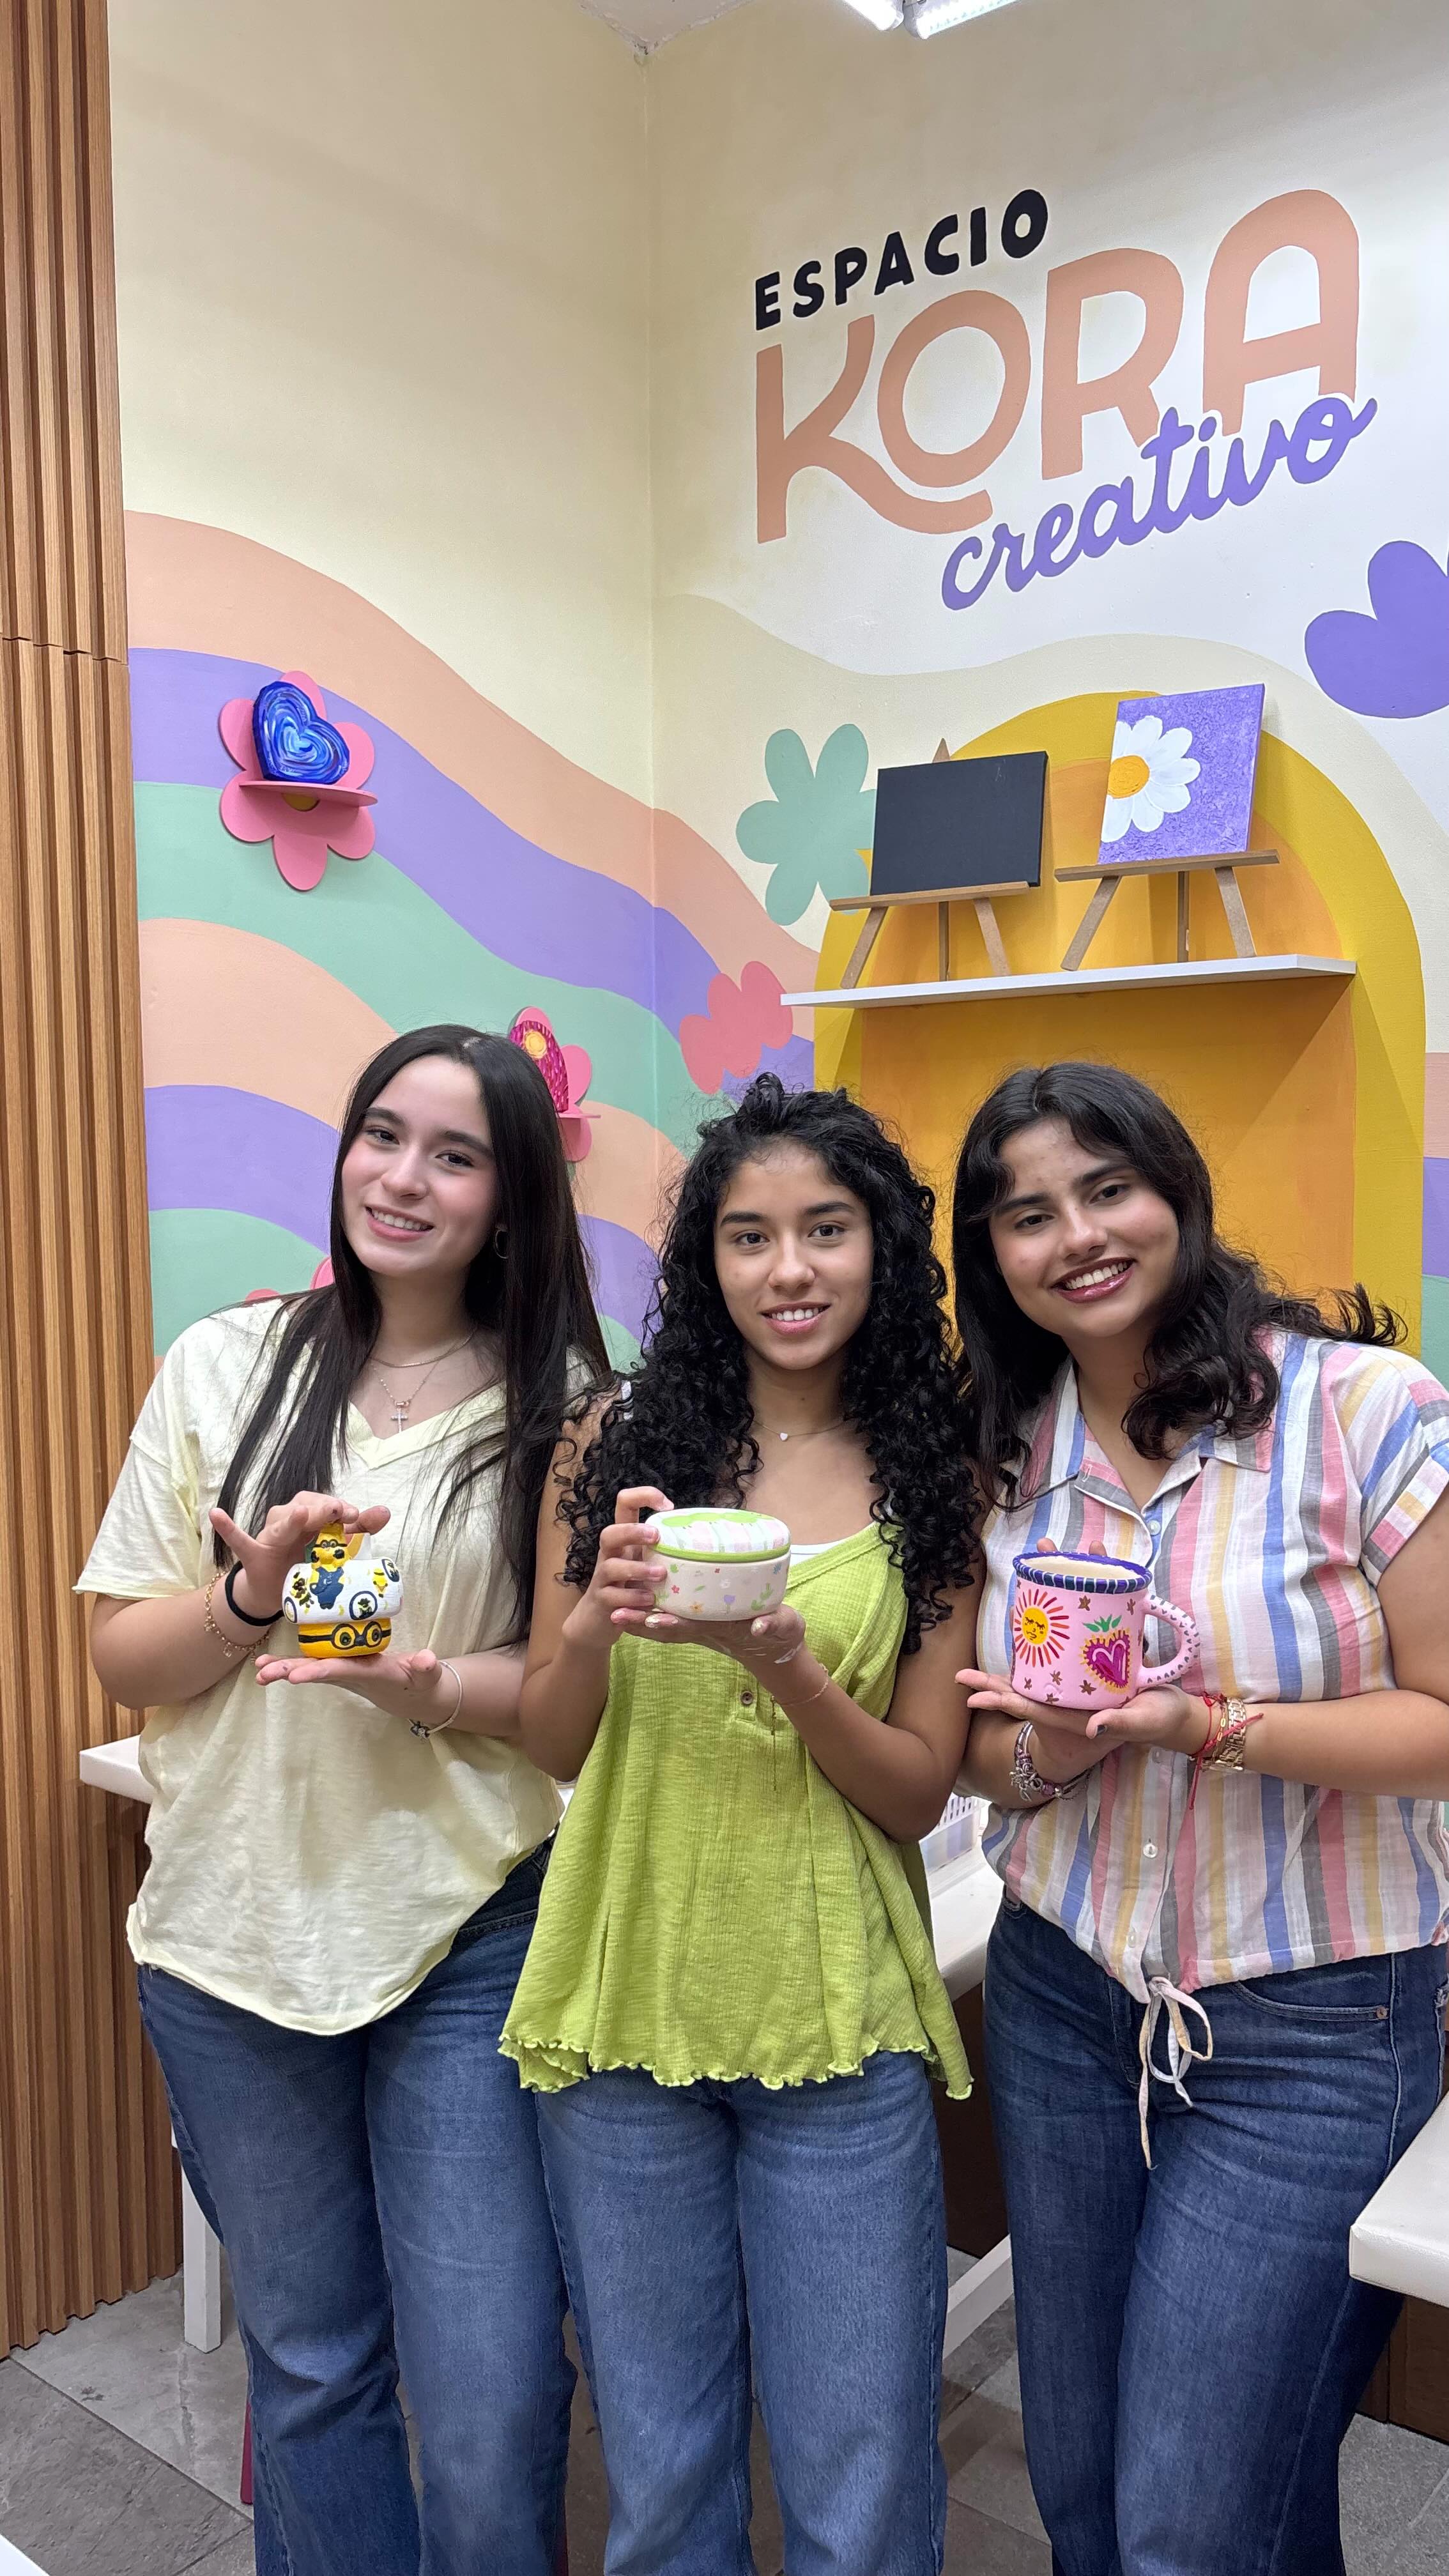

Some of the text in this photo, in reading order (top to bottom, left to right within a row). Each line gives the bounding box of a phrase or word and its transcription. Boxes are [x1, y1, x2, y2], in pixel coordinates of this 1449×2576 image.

[756, 189, 1047, 330] ESPACIO
[756, 189, 1359, 543] KORA
[941, 397, 1377, 611] creativo
